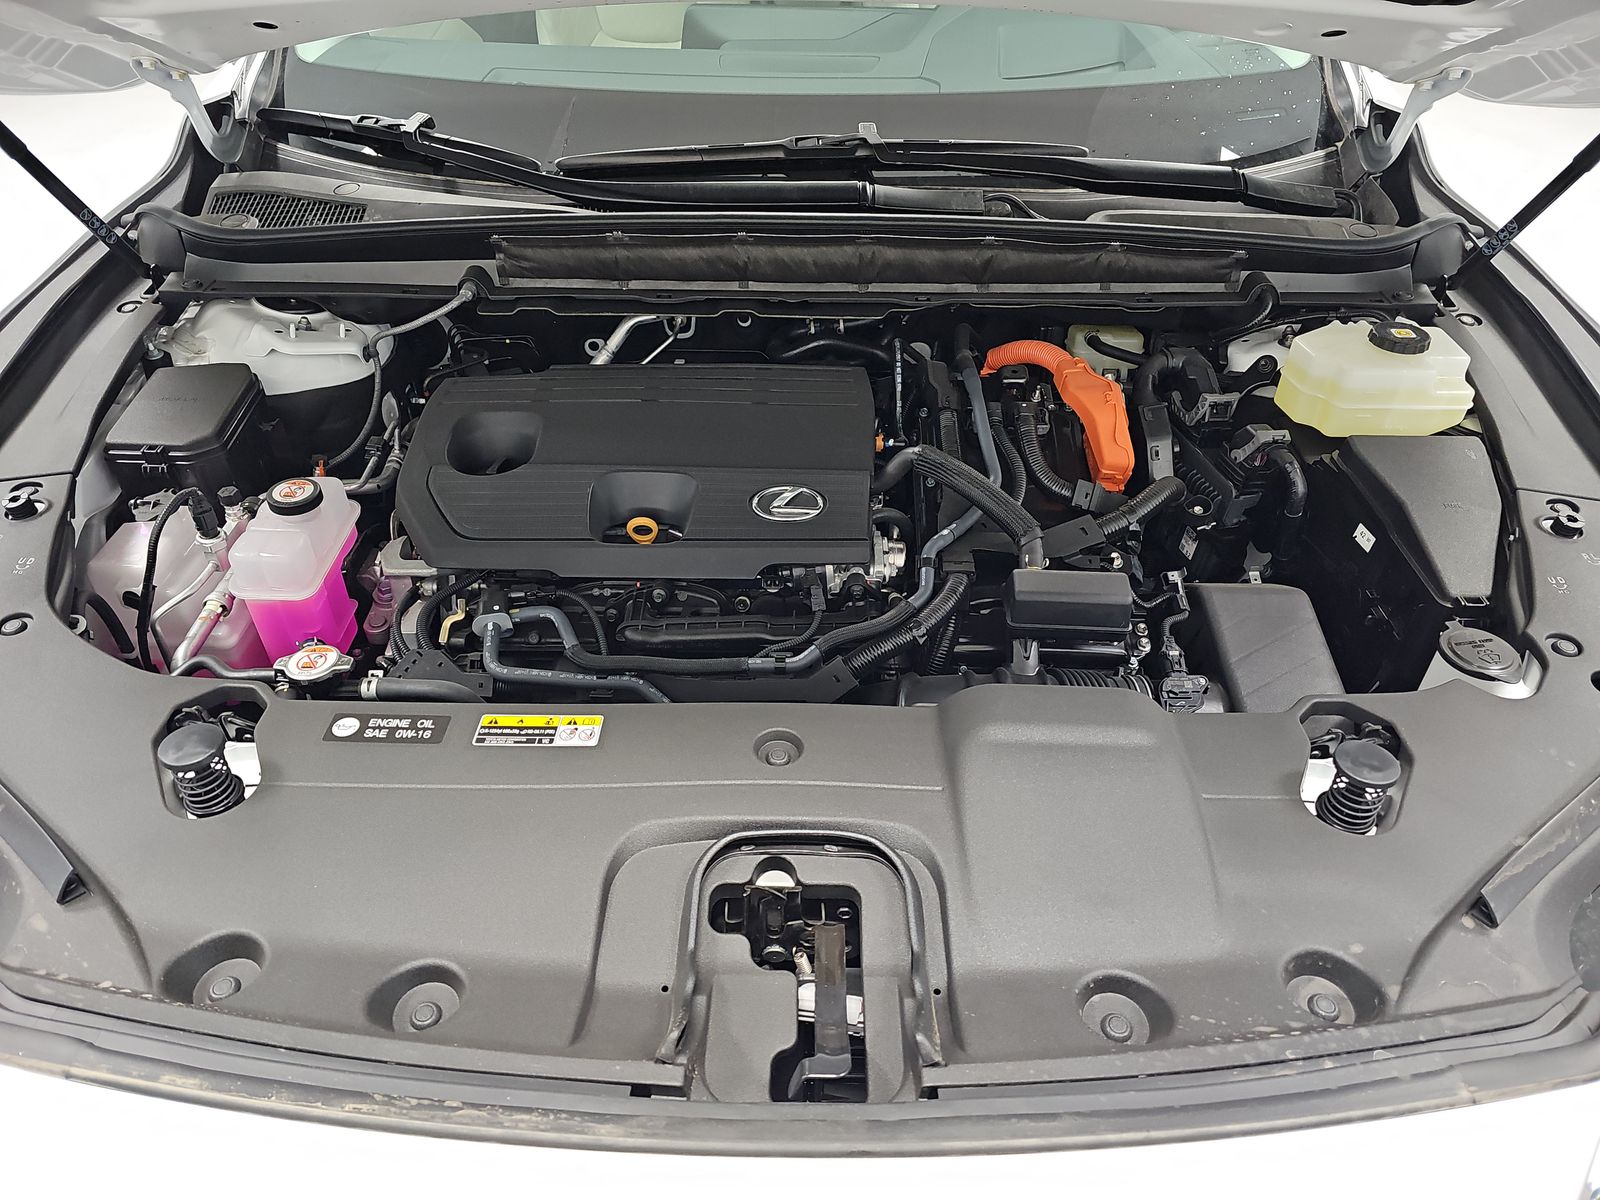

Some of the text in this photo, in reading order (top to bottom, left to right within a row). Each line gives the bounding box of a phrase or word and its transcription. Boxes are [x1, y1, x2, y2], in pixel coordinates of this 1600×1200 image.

[367, 718, 436, 729] ENGINE OIL
[363, 728, 432, 739] SAE 0W-16
